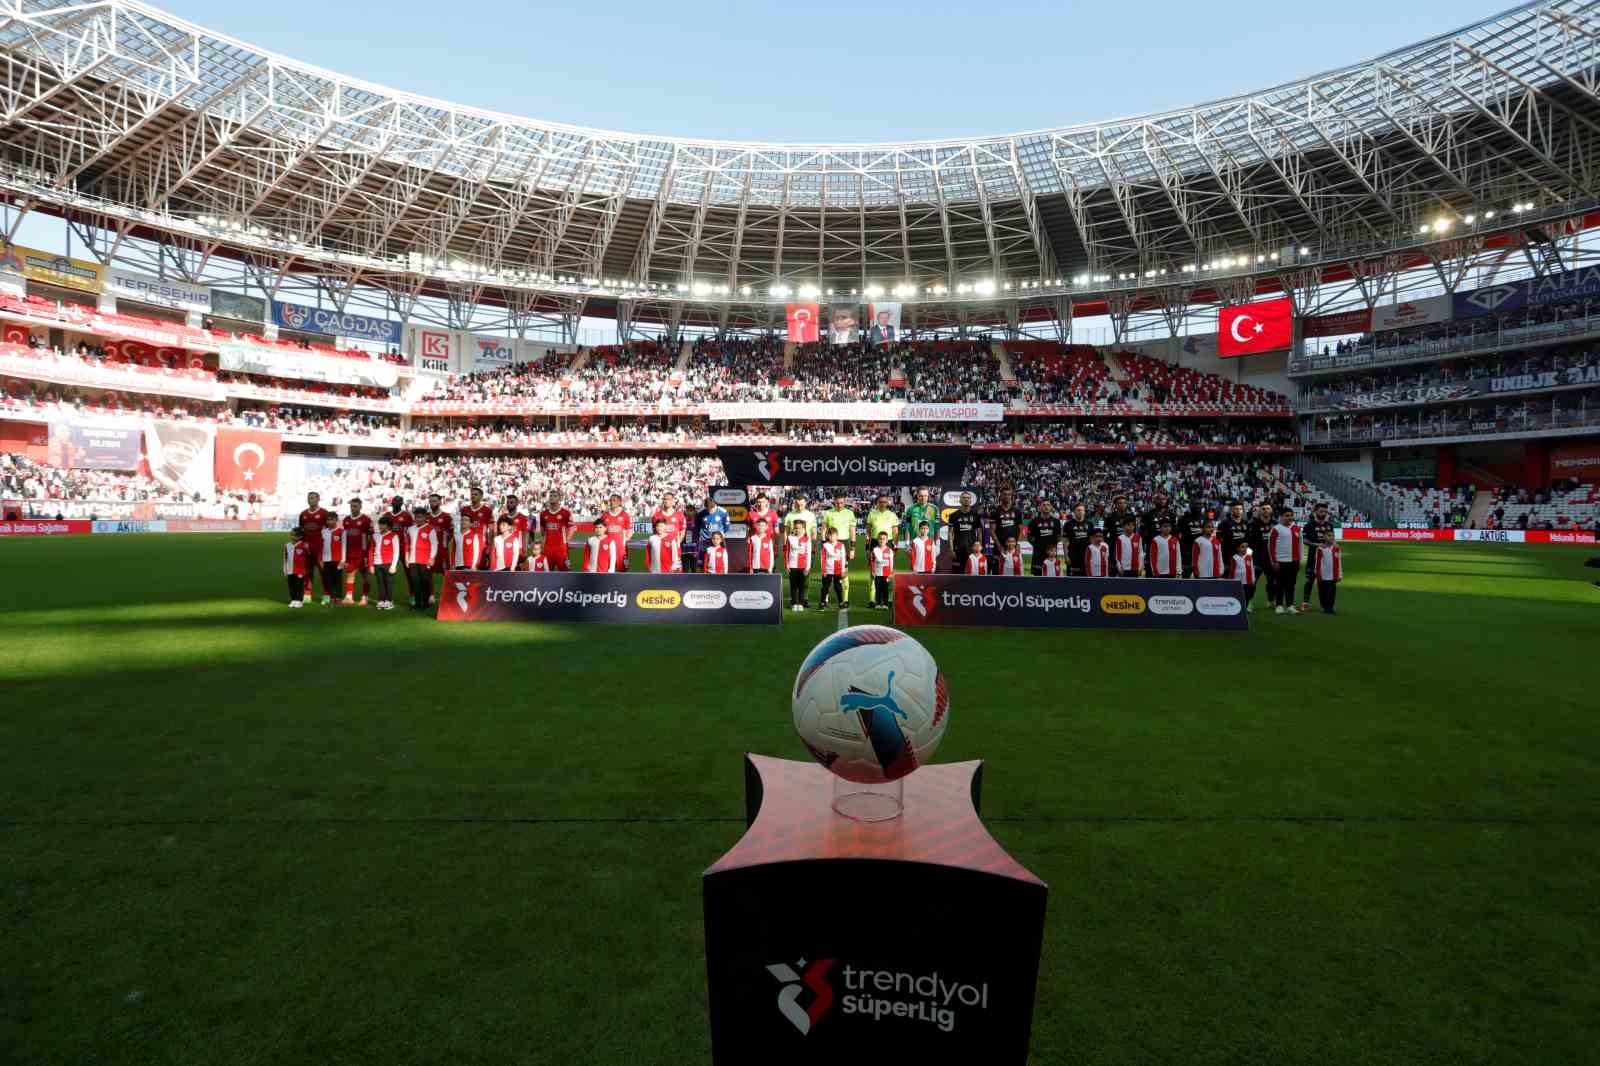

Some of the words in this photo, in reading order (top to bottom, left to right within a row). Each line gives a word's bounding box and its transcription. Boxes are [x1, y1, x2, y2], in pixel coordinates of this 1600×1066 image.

[910, 407, 978, 419] ANTALYASPOR
[783, 456, 866, 476] trendyol
[485, 587, 563, 606] trendyol
[942, 590, 1024, 611] trendyol
[842, 964, 988, 1009] trendyol
